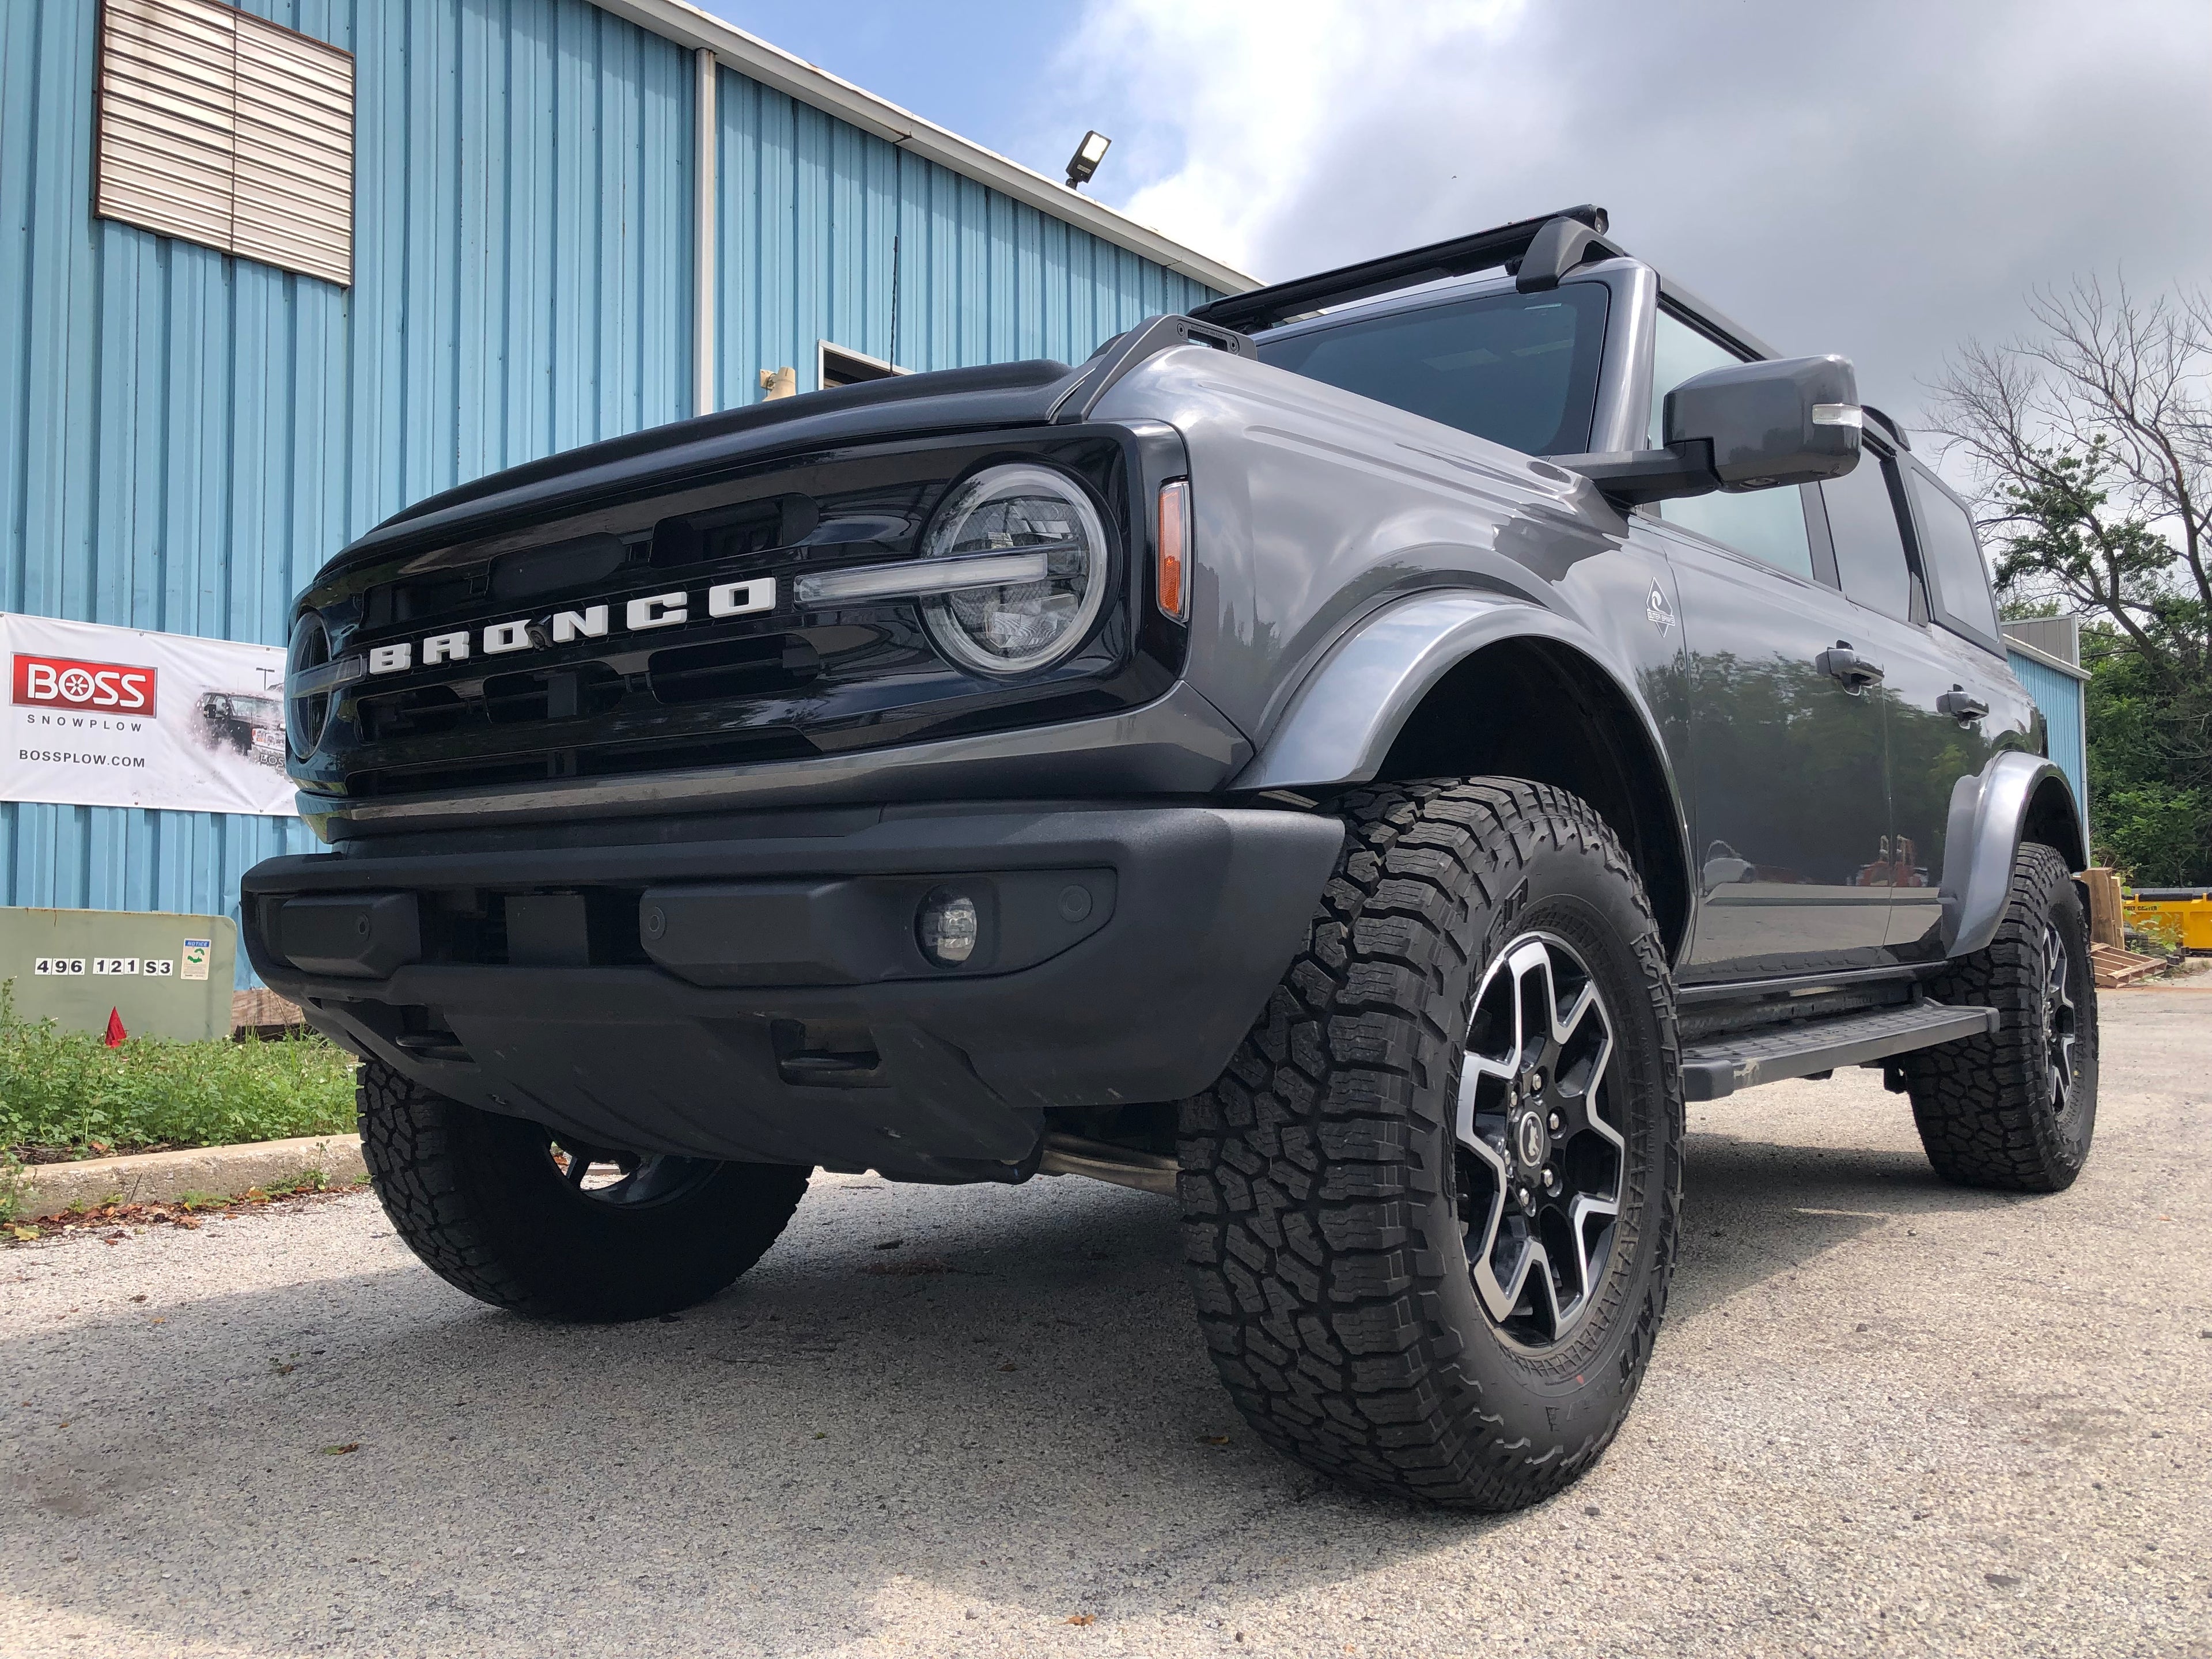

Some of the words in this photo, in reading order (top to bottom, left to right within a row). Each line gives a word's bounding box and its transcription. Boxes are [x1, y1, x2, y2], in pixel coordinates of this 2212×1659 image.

[369, 577, 777, 676] BRONCO
[27, 663, 146, 709] BOSS
[27, 714, 142, 732] SNOWPLOW
[19, 749, 145, 768] BOSSPLOW.COM
[37, 960, 82, 974] 496
[97, 960, 137, 973] 121
[146, 961, 171, 974] S3
